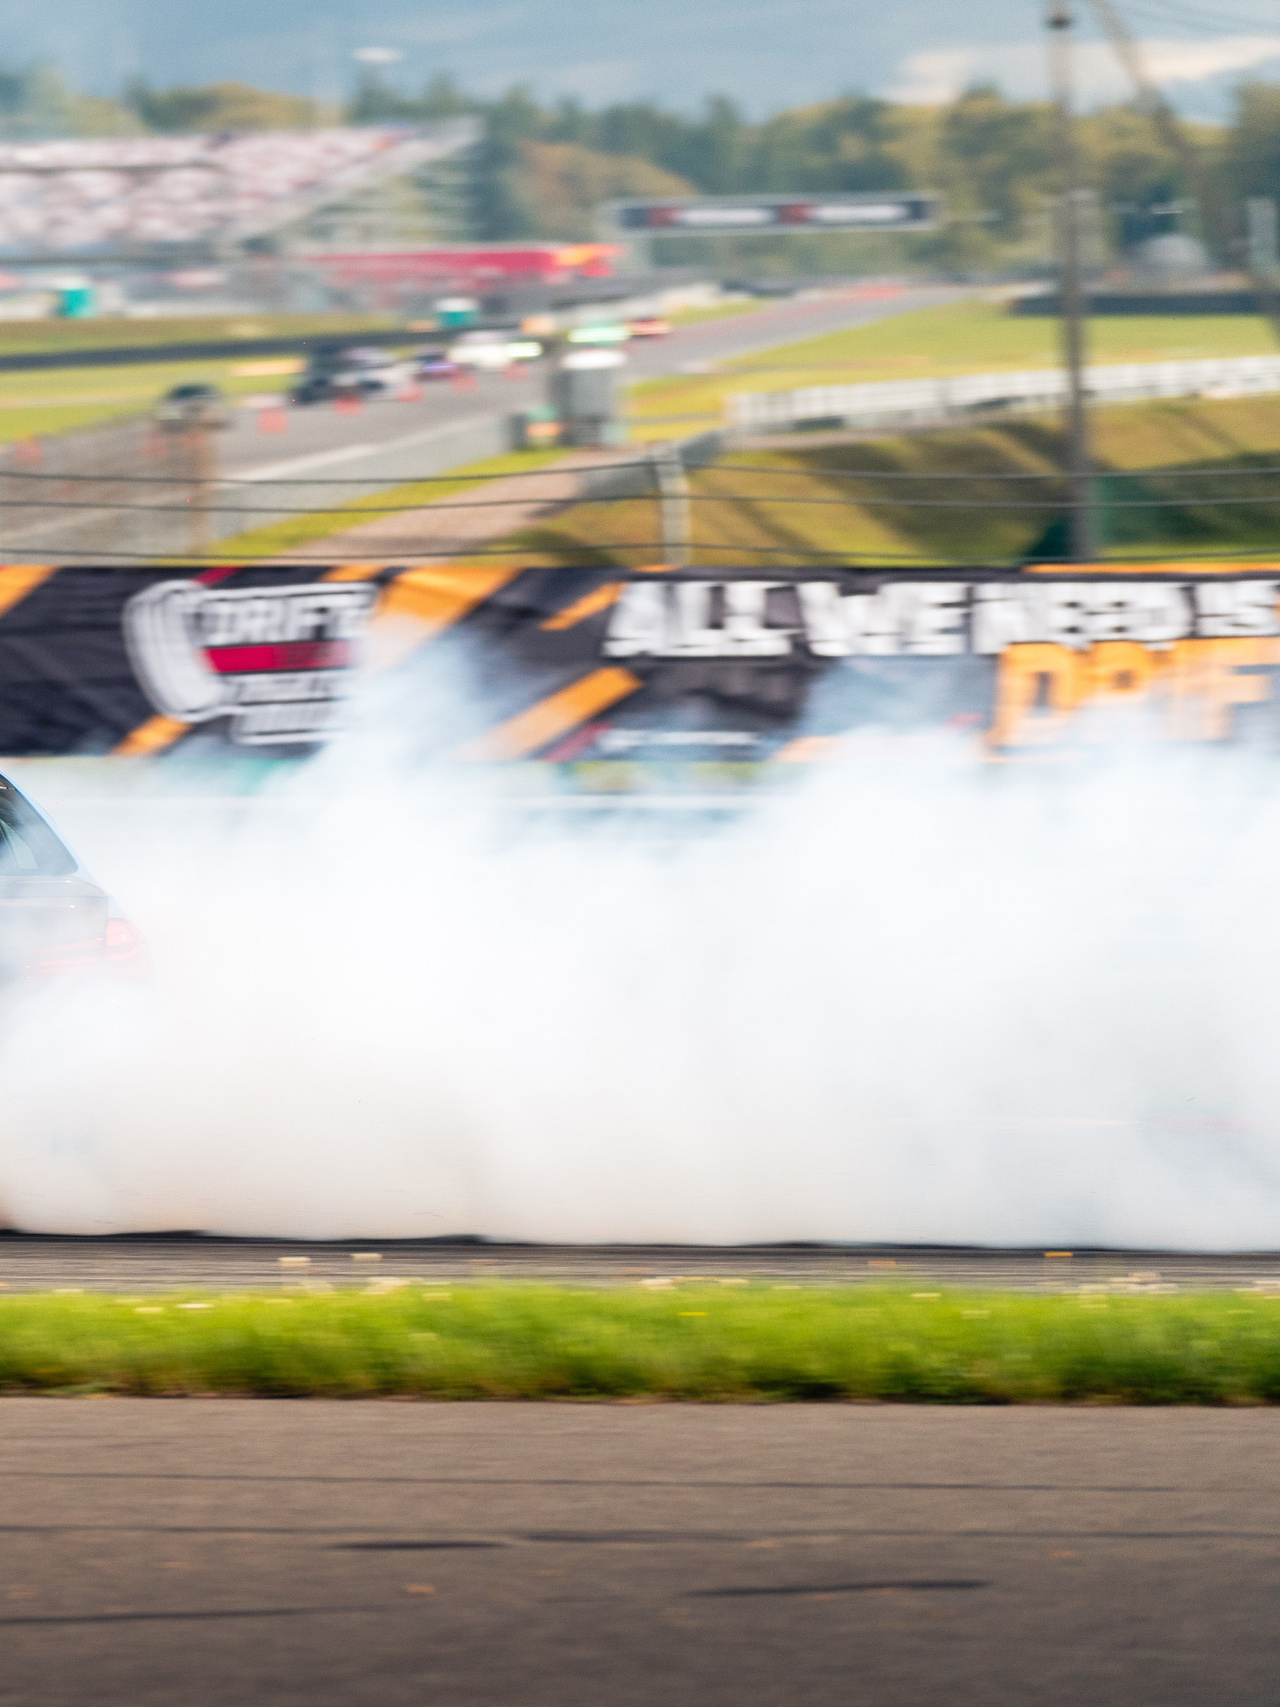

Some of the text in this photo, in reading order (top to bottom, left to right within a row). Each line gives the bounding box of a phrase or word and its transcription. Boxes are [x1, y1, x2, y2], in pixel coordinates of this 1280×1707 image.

[602, 579, 792, 657] ALL
[794, 580, 966, 657] WE
[970, 580, 1192, 654] NEED
